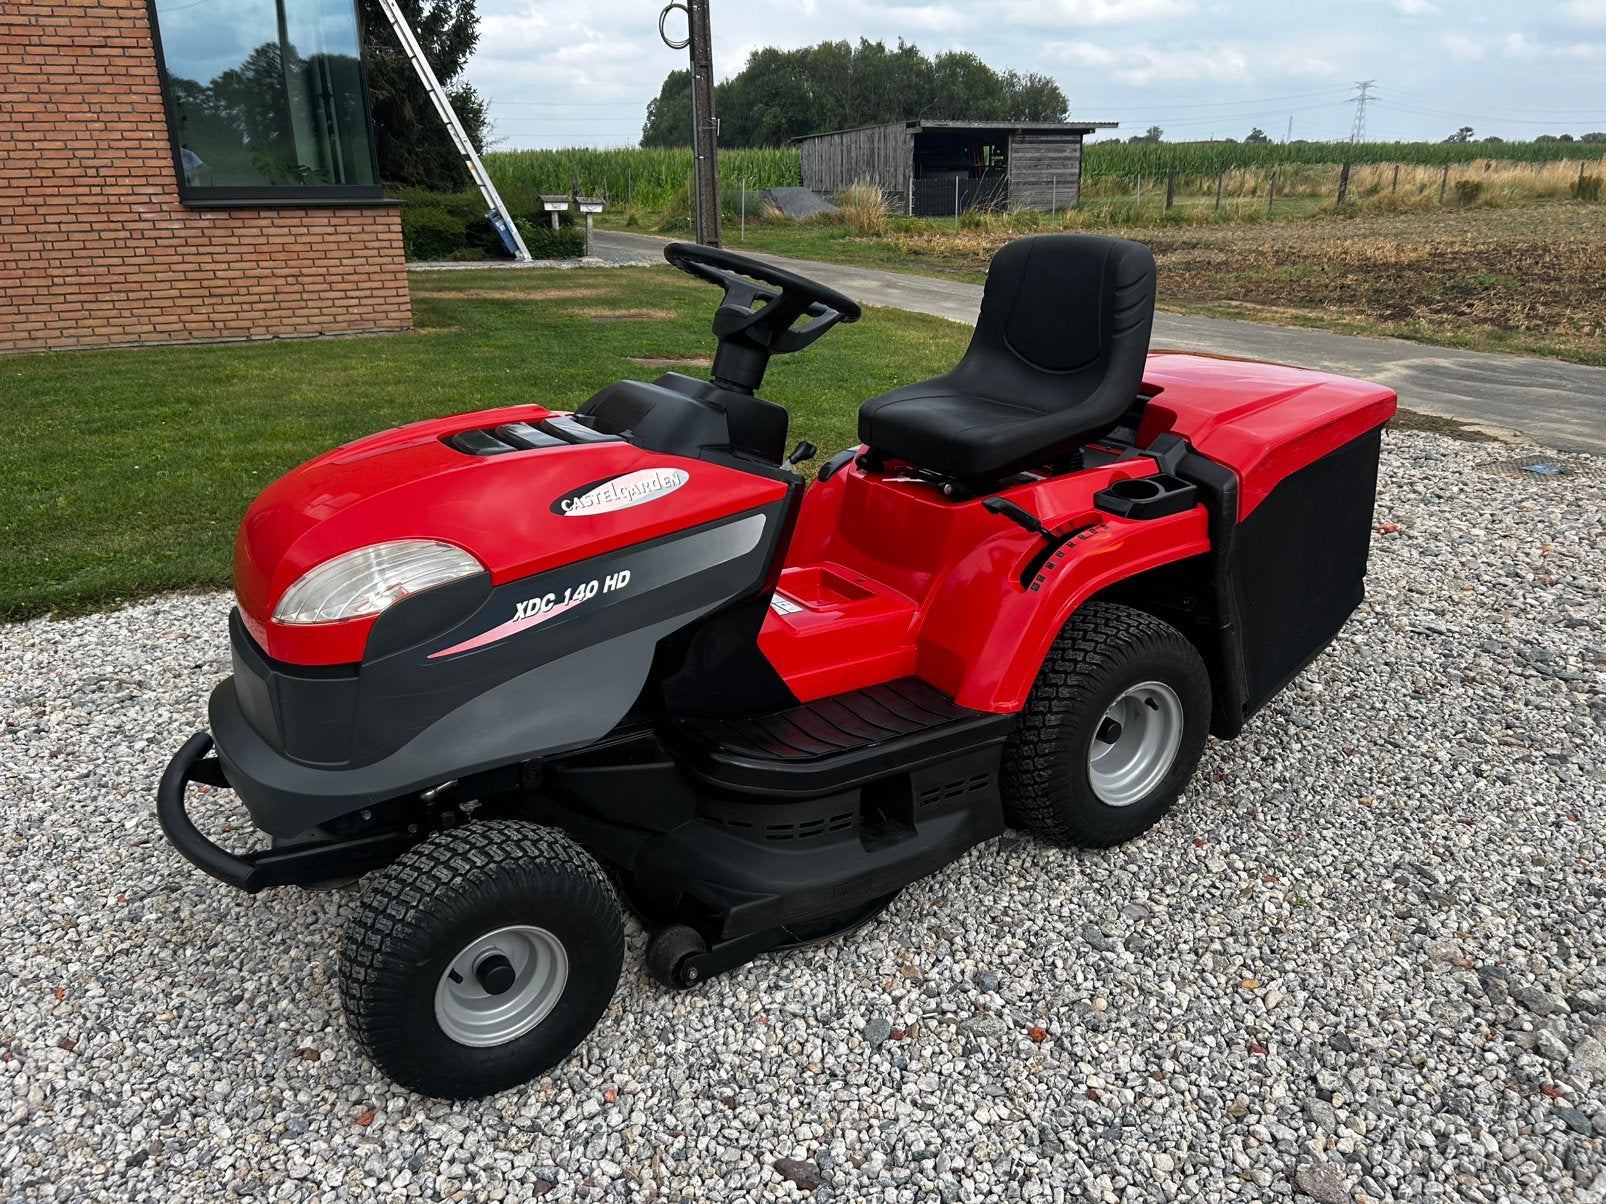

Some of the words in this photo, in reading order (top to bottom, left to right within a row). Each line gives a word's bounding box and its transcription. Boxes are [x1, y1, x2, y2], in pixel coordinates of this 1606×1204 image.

[512, 593, 556, 622] XDC
[563, 580, 599, 606] 140
[603, 570, 631, 593] HD
